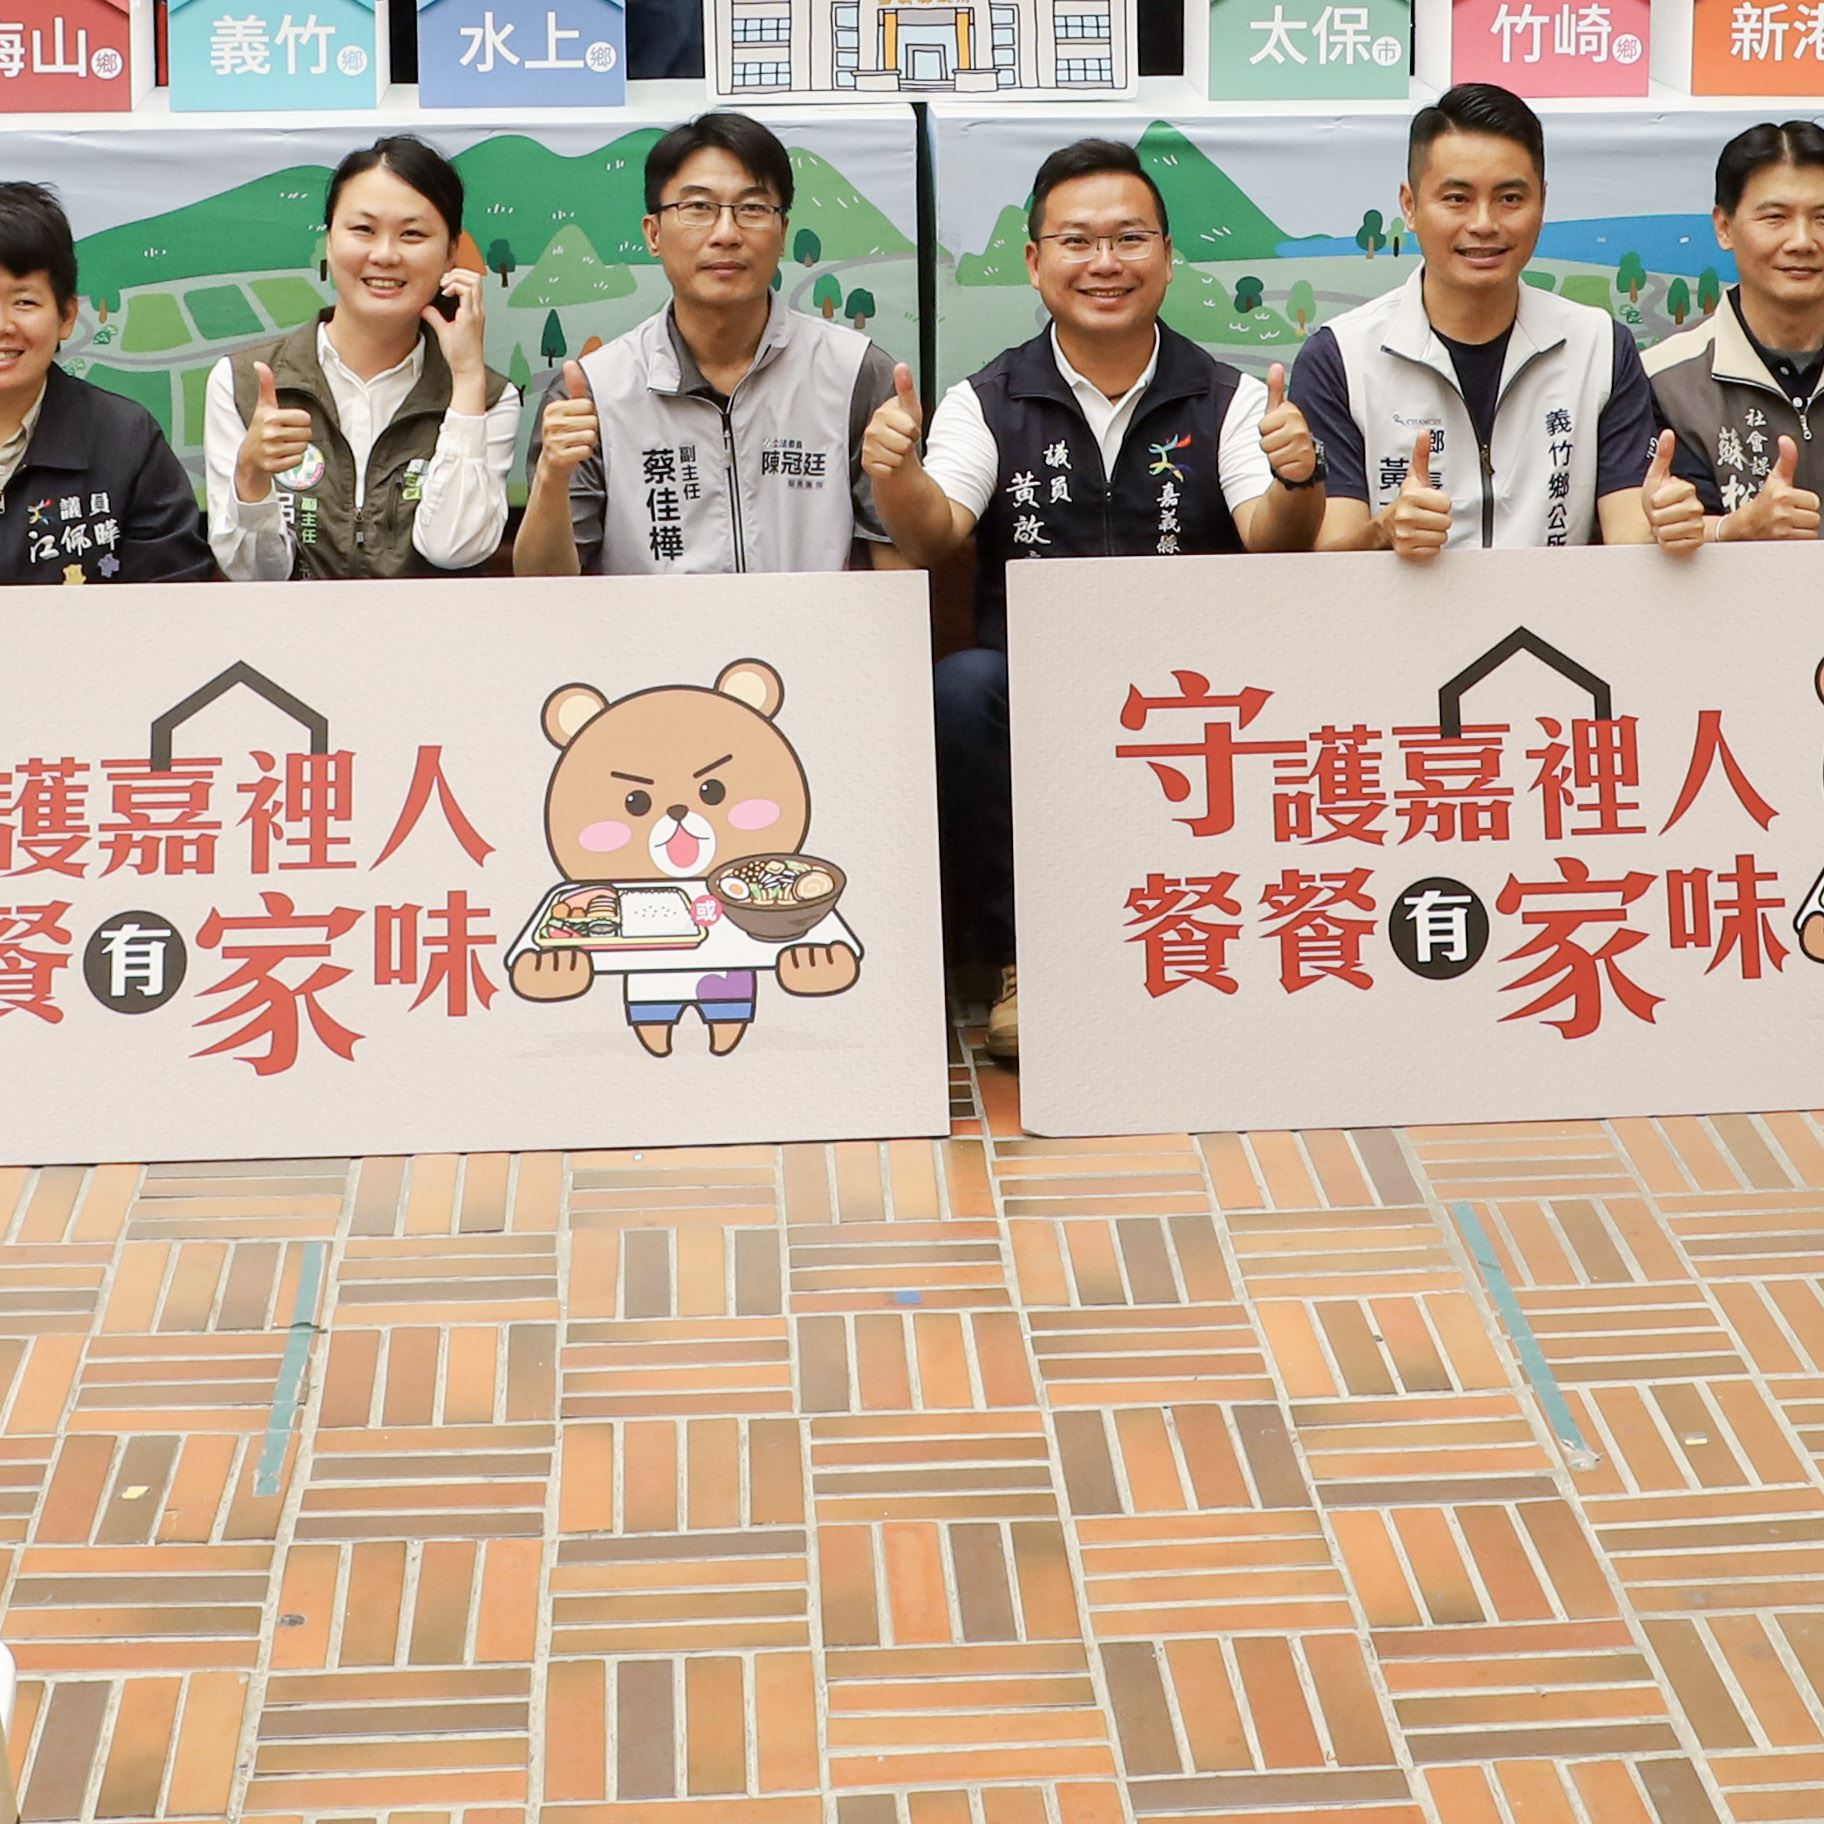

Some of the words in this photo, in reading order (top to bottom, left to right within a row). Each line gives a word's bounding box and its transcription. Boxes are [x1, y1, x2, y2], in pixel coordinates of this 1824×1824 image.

[678, 444, 701, 501] 副主任
[761, 451, 827, 477] 陳冠廷
[1042, 439, 1073, 504] 議員
[1744, 408, 1773, 494] 社會課
[59, 491, 111, 521] 議員
[642, 448, 685, 562] 蔡佳樺
[1005, 470, 1052, 558] 黃啟
[1115, 670, 1781, 847] 守護嘉裡人
[696, 898, 720, 922] 或
[1123, 856, 1790, 1040] 餐餐有家味
